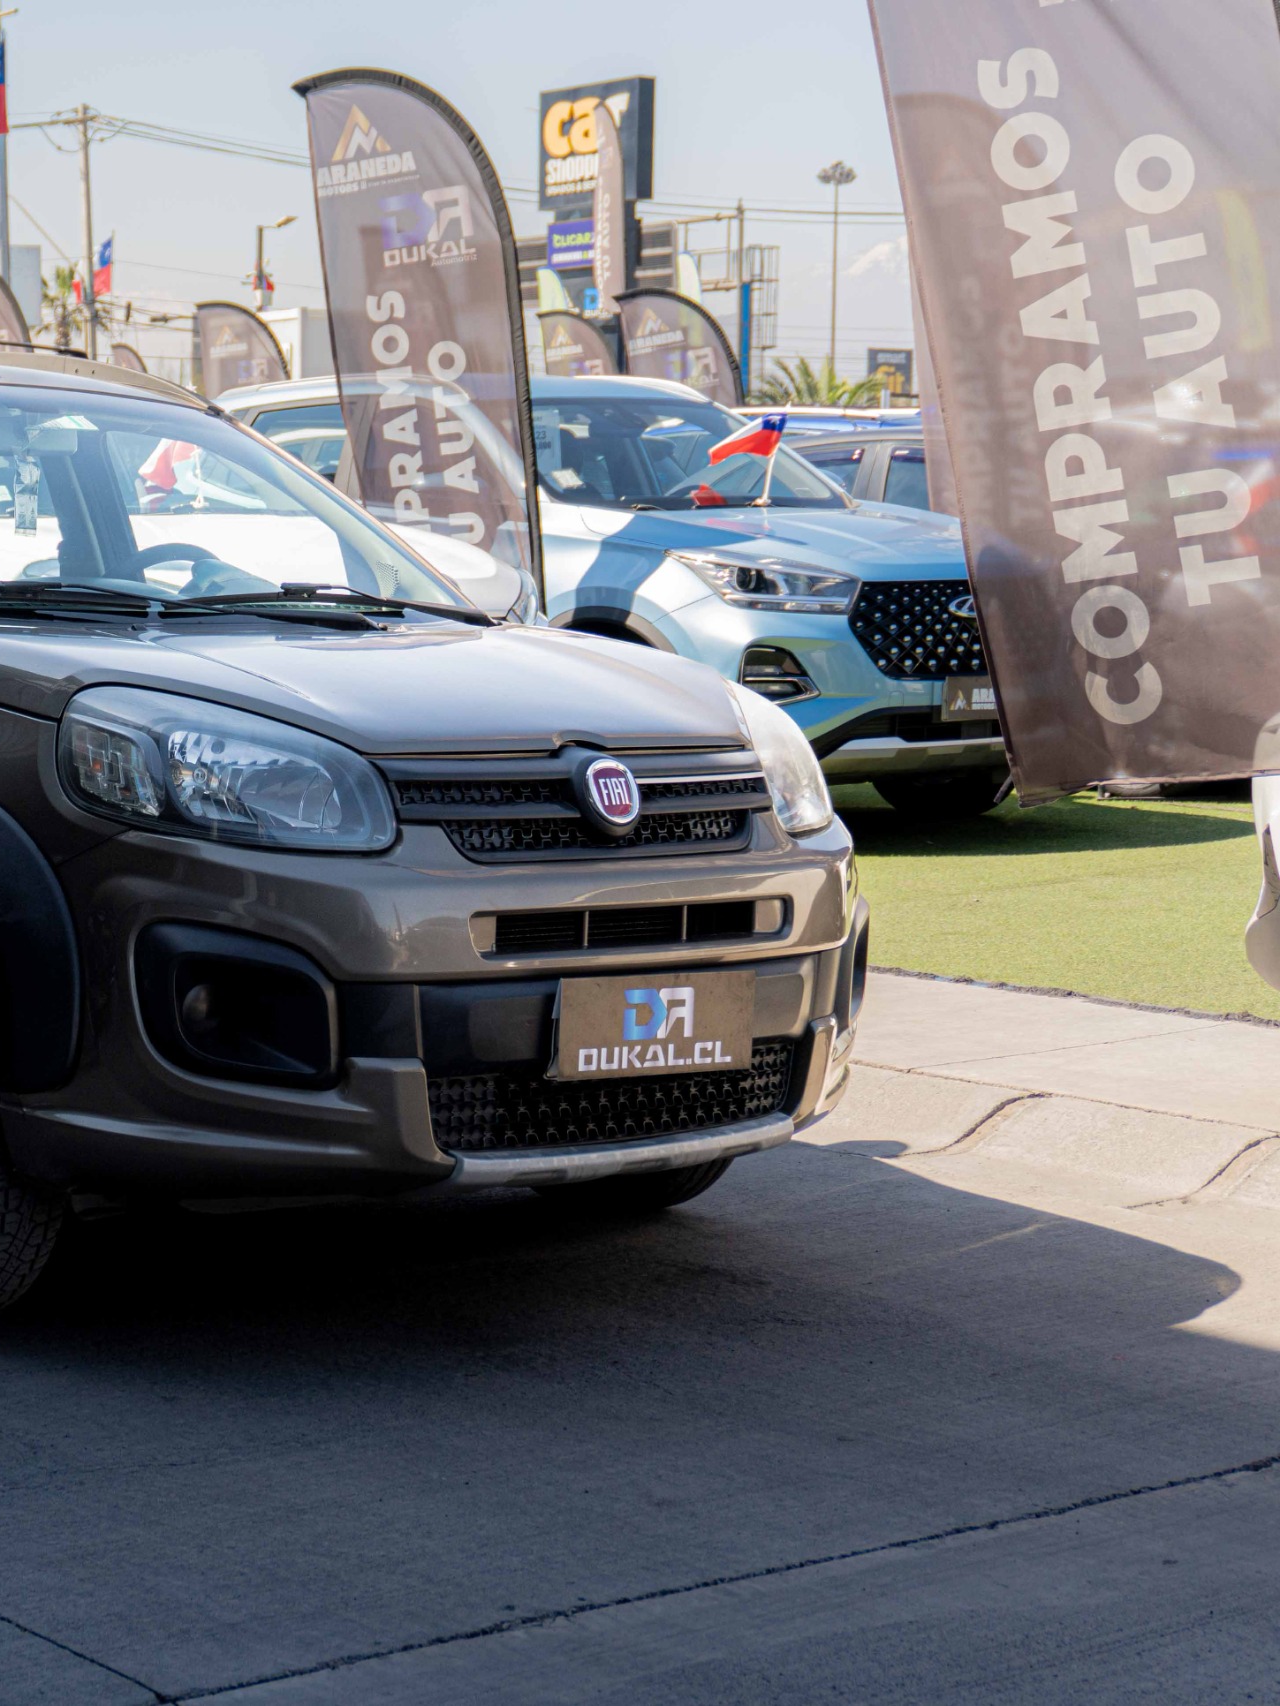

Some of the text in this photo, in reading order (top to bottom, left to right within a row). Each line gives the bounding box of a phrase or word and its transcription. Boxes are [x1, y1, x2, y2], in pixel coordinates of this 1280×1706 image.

[317, 151, 416, 188] ARANEDA
[317, 181, 359, 198] MOTORS
[384, 238, 477, 267] DUKAL
[977, 47, 1163, 725] COMPRAMOS
[1114, 134, 1262, 607] TU AUTO
[427, 340, 479, 493] AUTO
[598, 776, 629, 806] FIAT
[578, 1040, 732, 1072] DUKAL.CL
